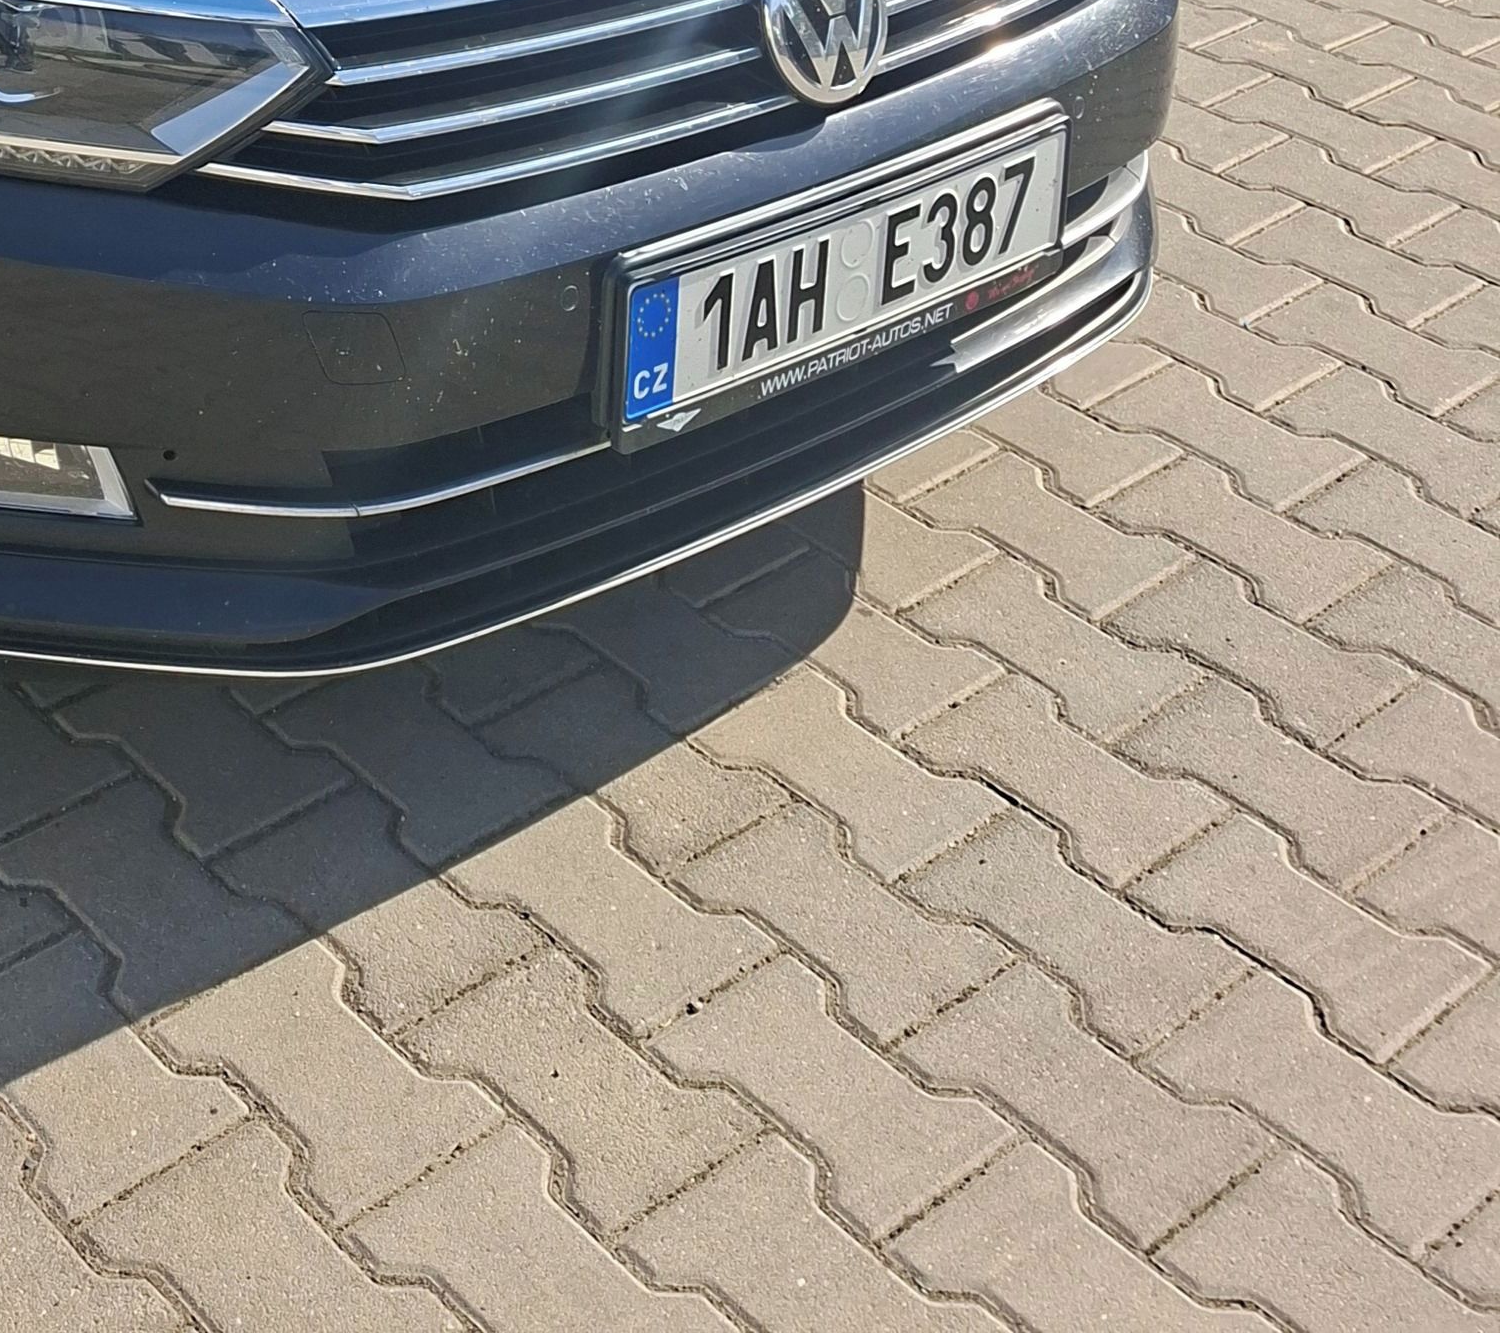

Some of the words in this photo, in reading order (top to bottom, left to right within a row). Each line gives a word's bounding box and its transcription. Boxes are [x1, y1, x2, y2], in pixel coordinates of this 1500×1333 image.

[703, 238, 830, 371] 1AH
[880, 155, 1036, 307] E387
[633, 362, 669, 400] CZ
[760, 302, 954, 397] WWW.PATRIOT-AUTOS.NET
